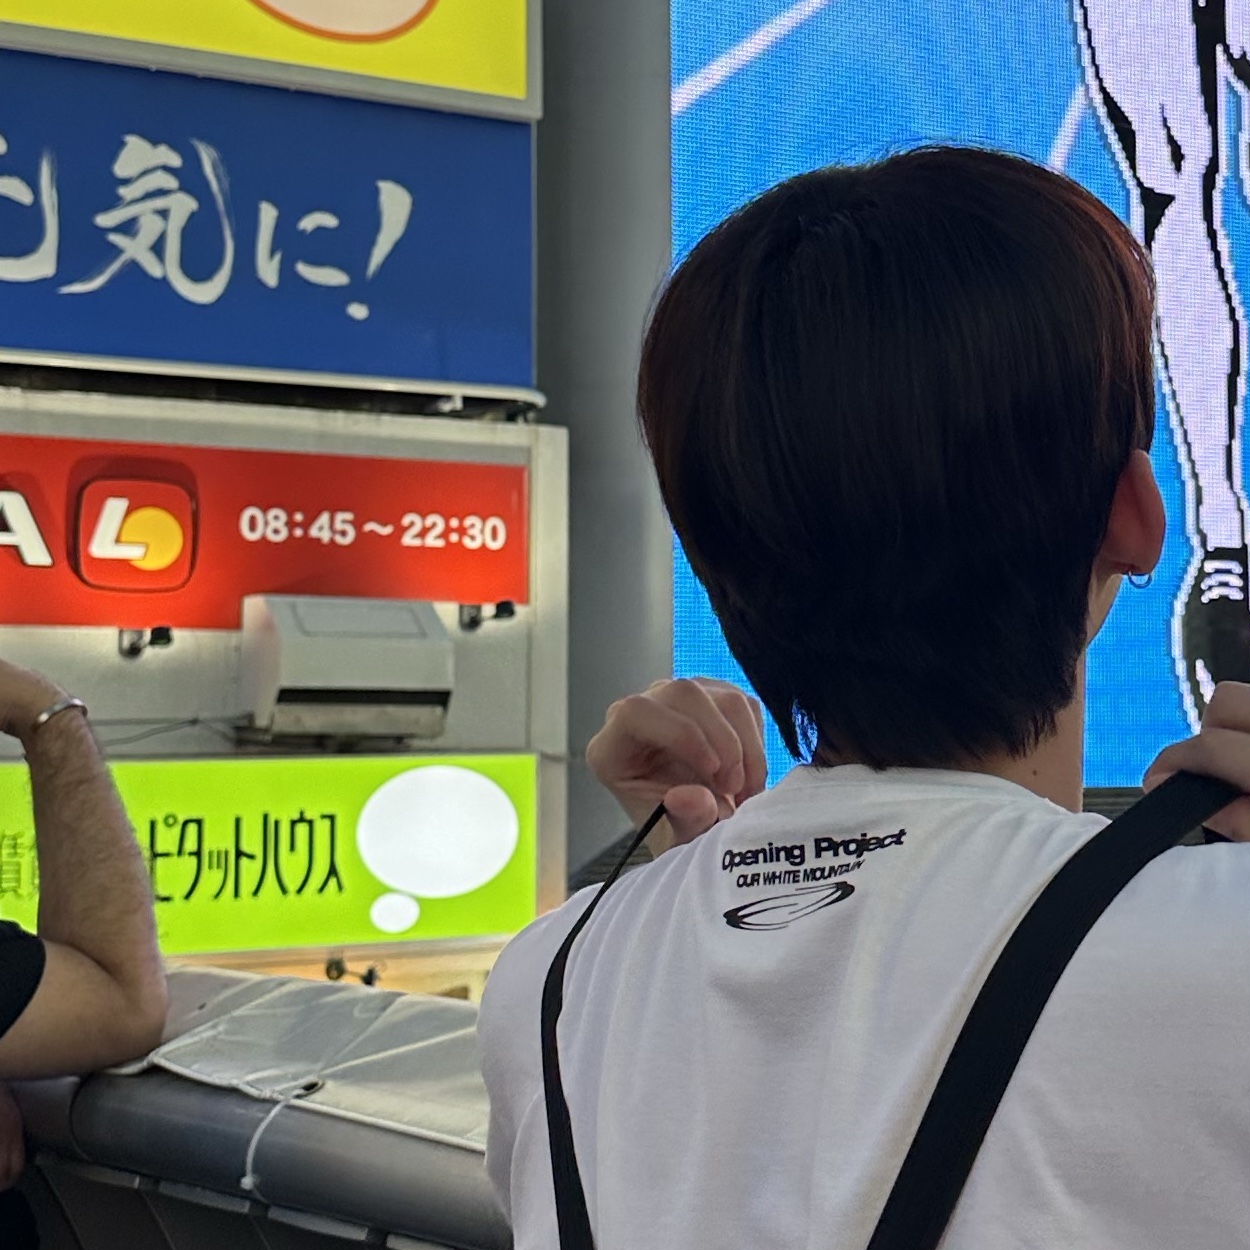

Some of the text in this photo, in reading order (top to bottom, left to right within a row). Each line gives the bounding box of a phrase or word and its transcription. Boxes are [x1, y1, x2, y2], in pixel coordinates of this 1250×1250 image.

[149, 808, 345, 903] ピタットハウス
[722, 828, 907, 873] Opening Project
[736, 871, 760, 888] OUR
[763, 869, 801, 886] WHITE
